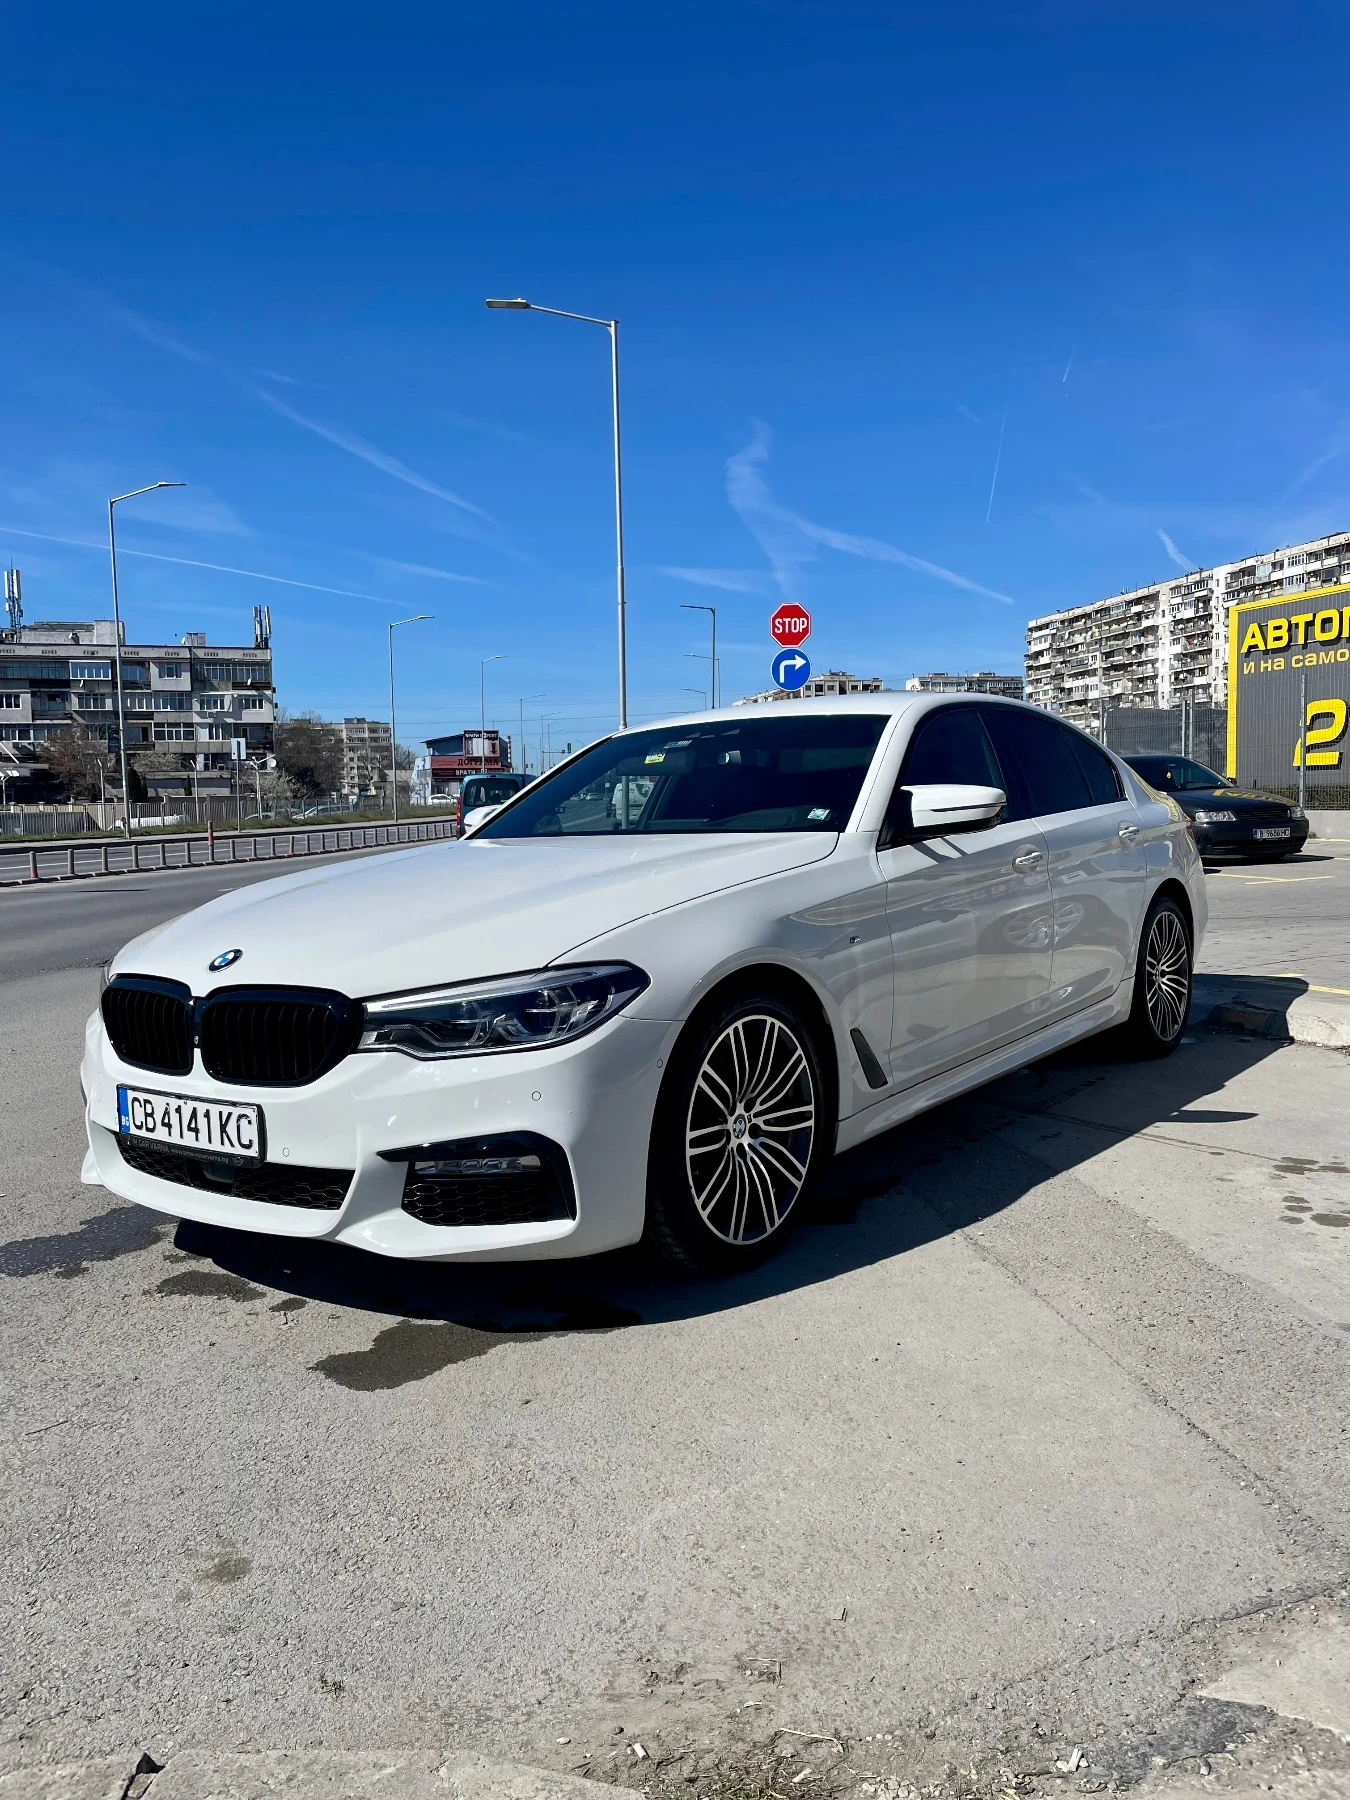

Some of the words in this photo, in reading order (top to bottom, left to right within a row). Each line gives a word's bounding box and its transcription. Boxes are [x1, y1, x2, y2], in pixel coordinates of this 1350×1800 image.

[775, 617, 808, 634] STOP
[1243, 661, 1255, 675] и
[1260, 657, 1285, 673] на
[1291, 648, 1350, 669] само
[1292, 698, 1347, 767] 2
[121, 1115, 130, 1126] BG
